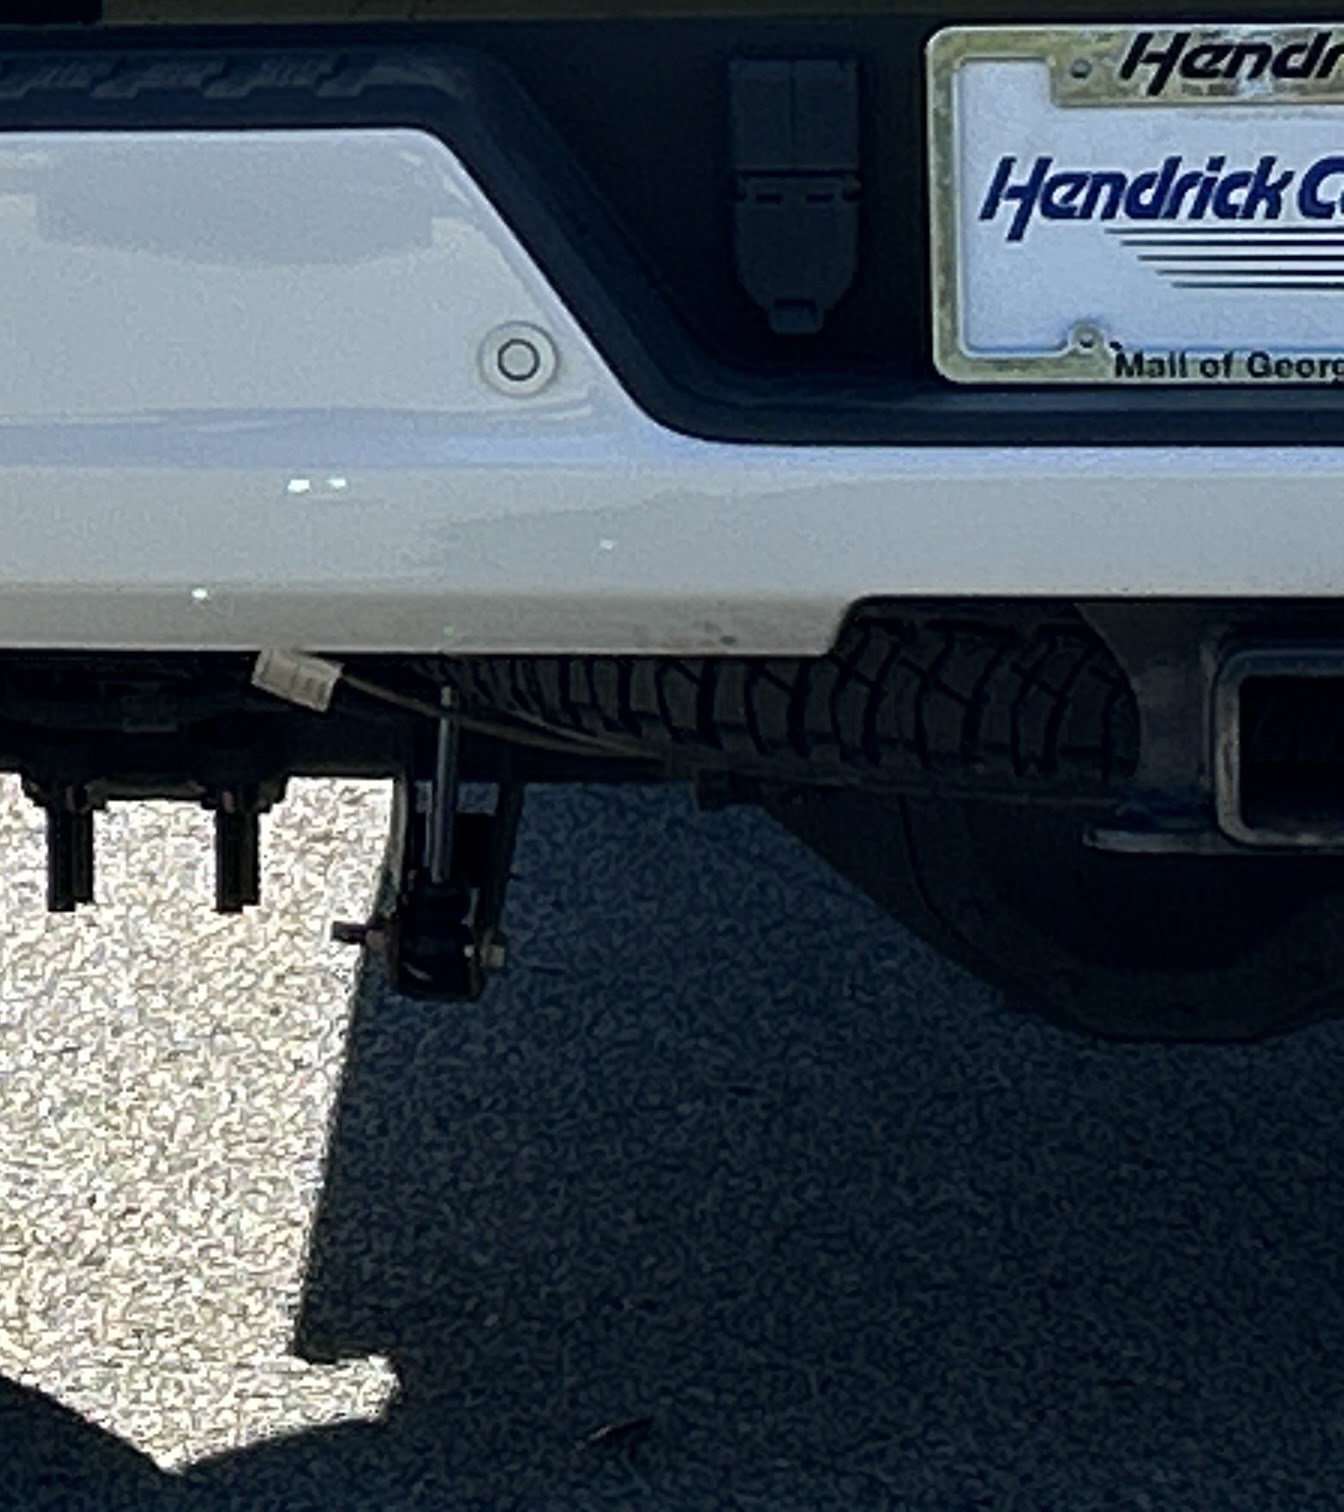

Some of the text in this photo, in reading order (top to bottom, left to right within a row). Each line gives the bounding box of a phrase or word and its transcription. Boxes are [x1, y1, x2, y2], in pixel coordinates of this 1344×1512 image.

[977, 154, 1344, 243] Hendrick C
[1114, 350, 1188, 379] Mall
[1199, 350, 1234, 379] of
